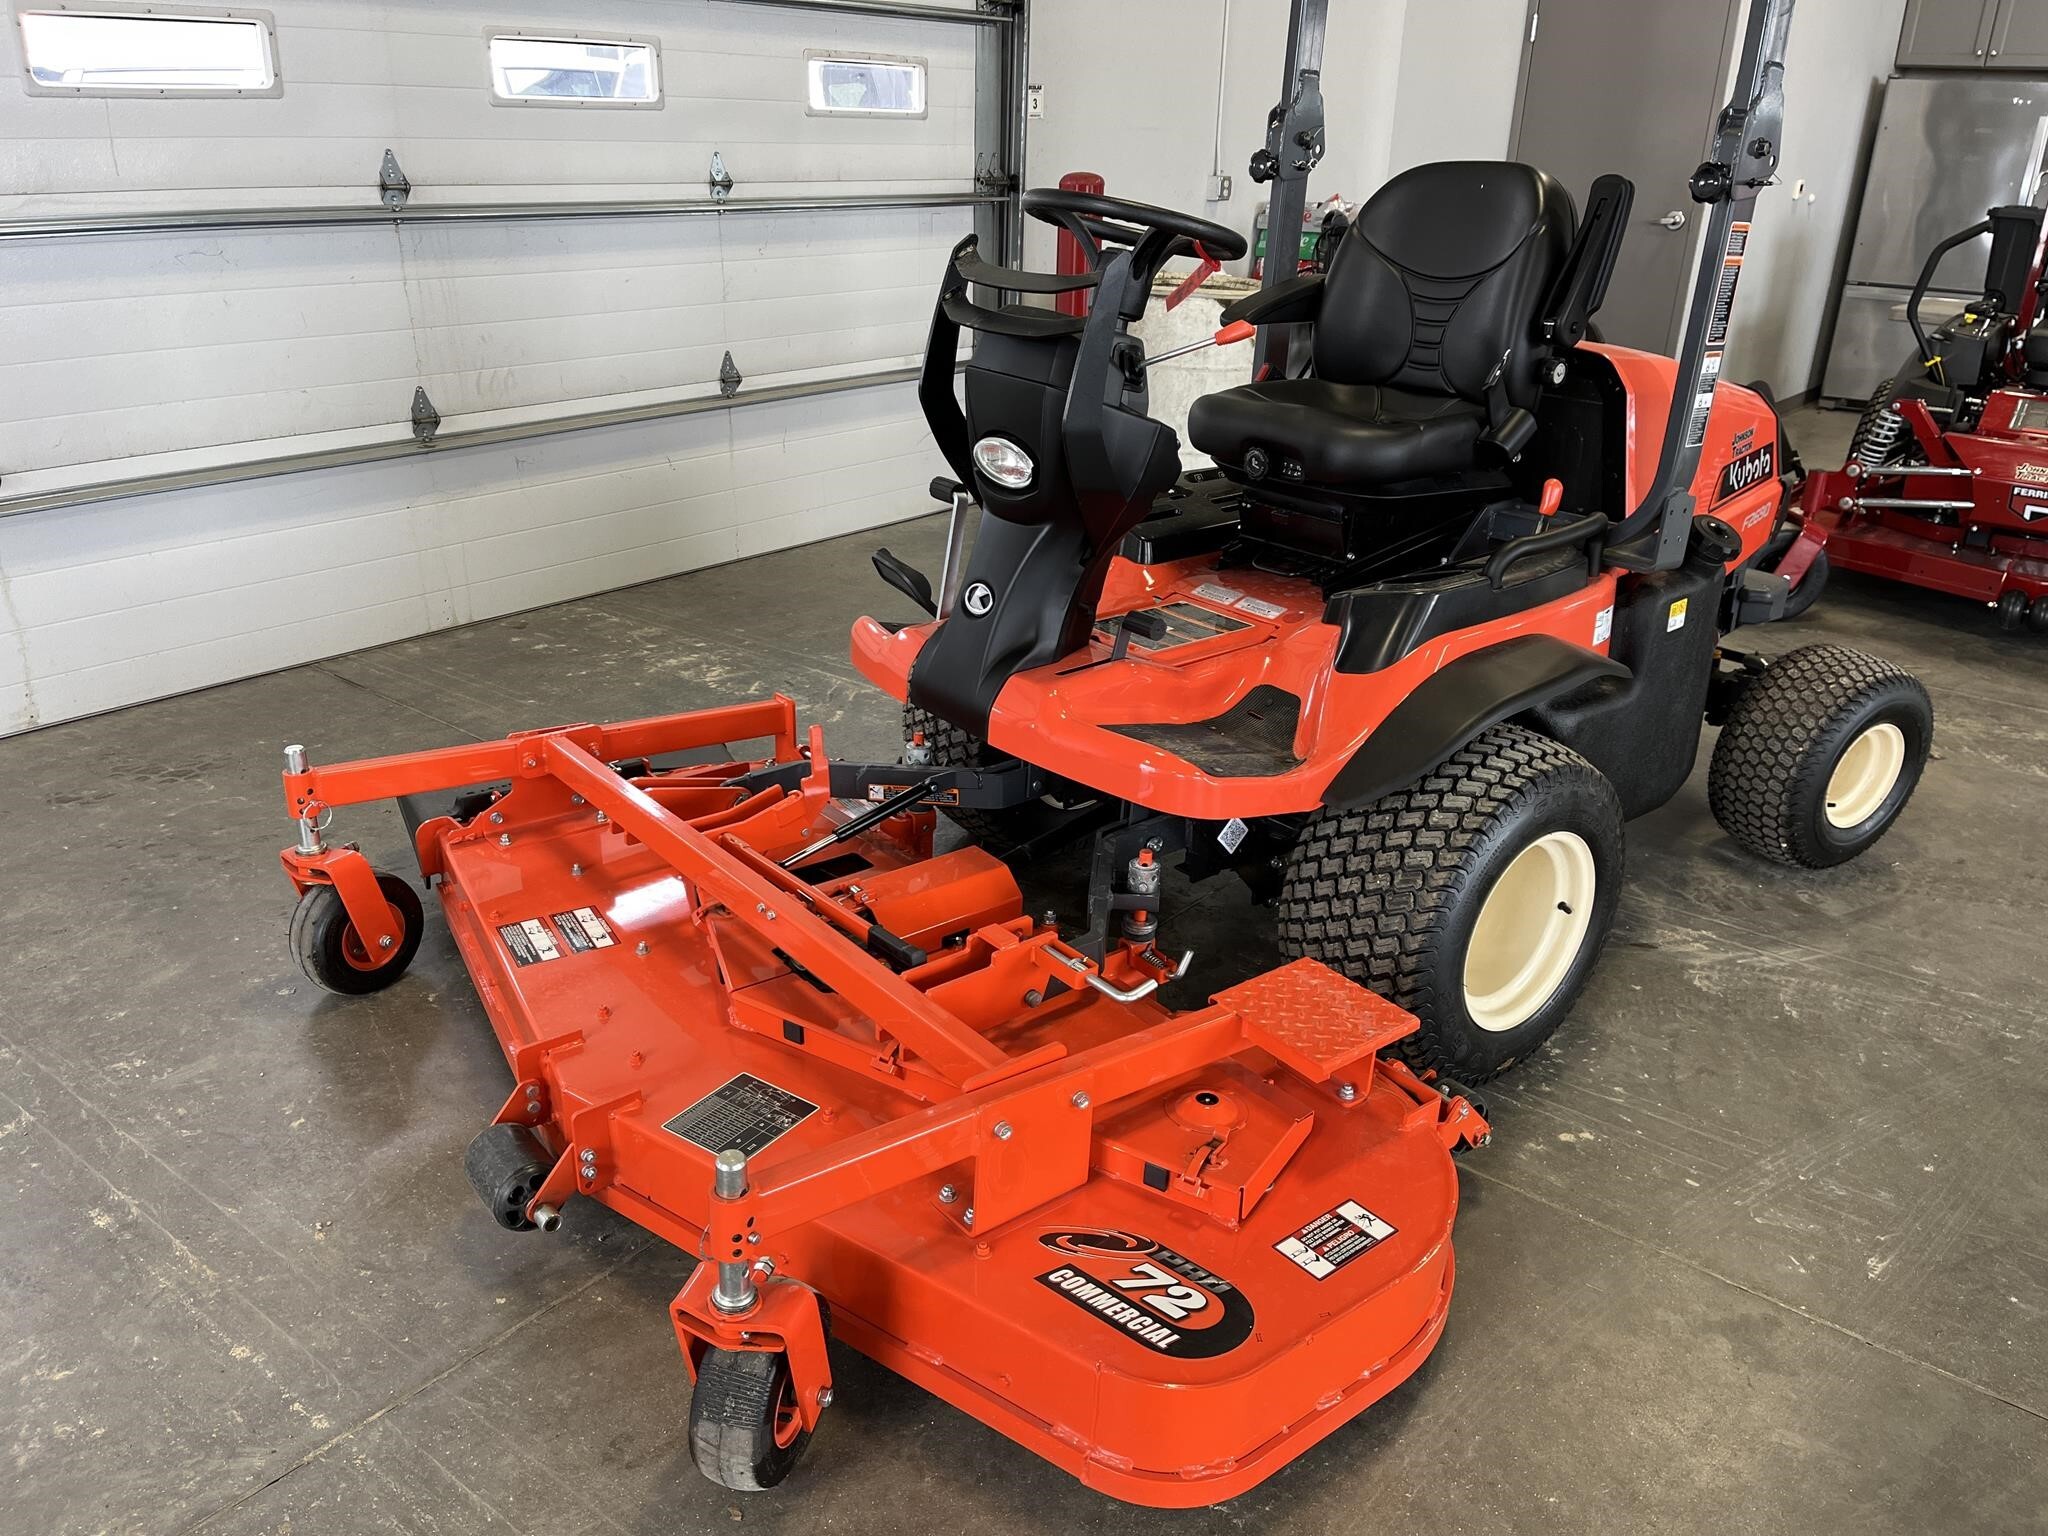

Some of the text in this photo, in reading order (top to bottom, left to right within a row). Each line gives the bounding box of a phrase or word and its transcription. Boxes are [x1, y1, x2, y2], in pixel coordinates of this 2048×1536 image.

[1032, 98, 1038, 110] 3
[1732, 428, 1755, 446] JOHNSON
[1729, 448, 1771, 490] Kubota
[1305, 1213, 1333, 1230] DANGER
[1326, 1229, 1356, 1249] PELIGRO
[1151, 1249, 1232, 1294] PRO
[1112, 1262, 1207, 1320] 72
[1048, 1269, 1182, 1349] COMMERCIAL
